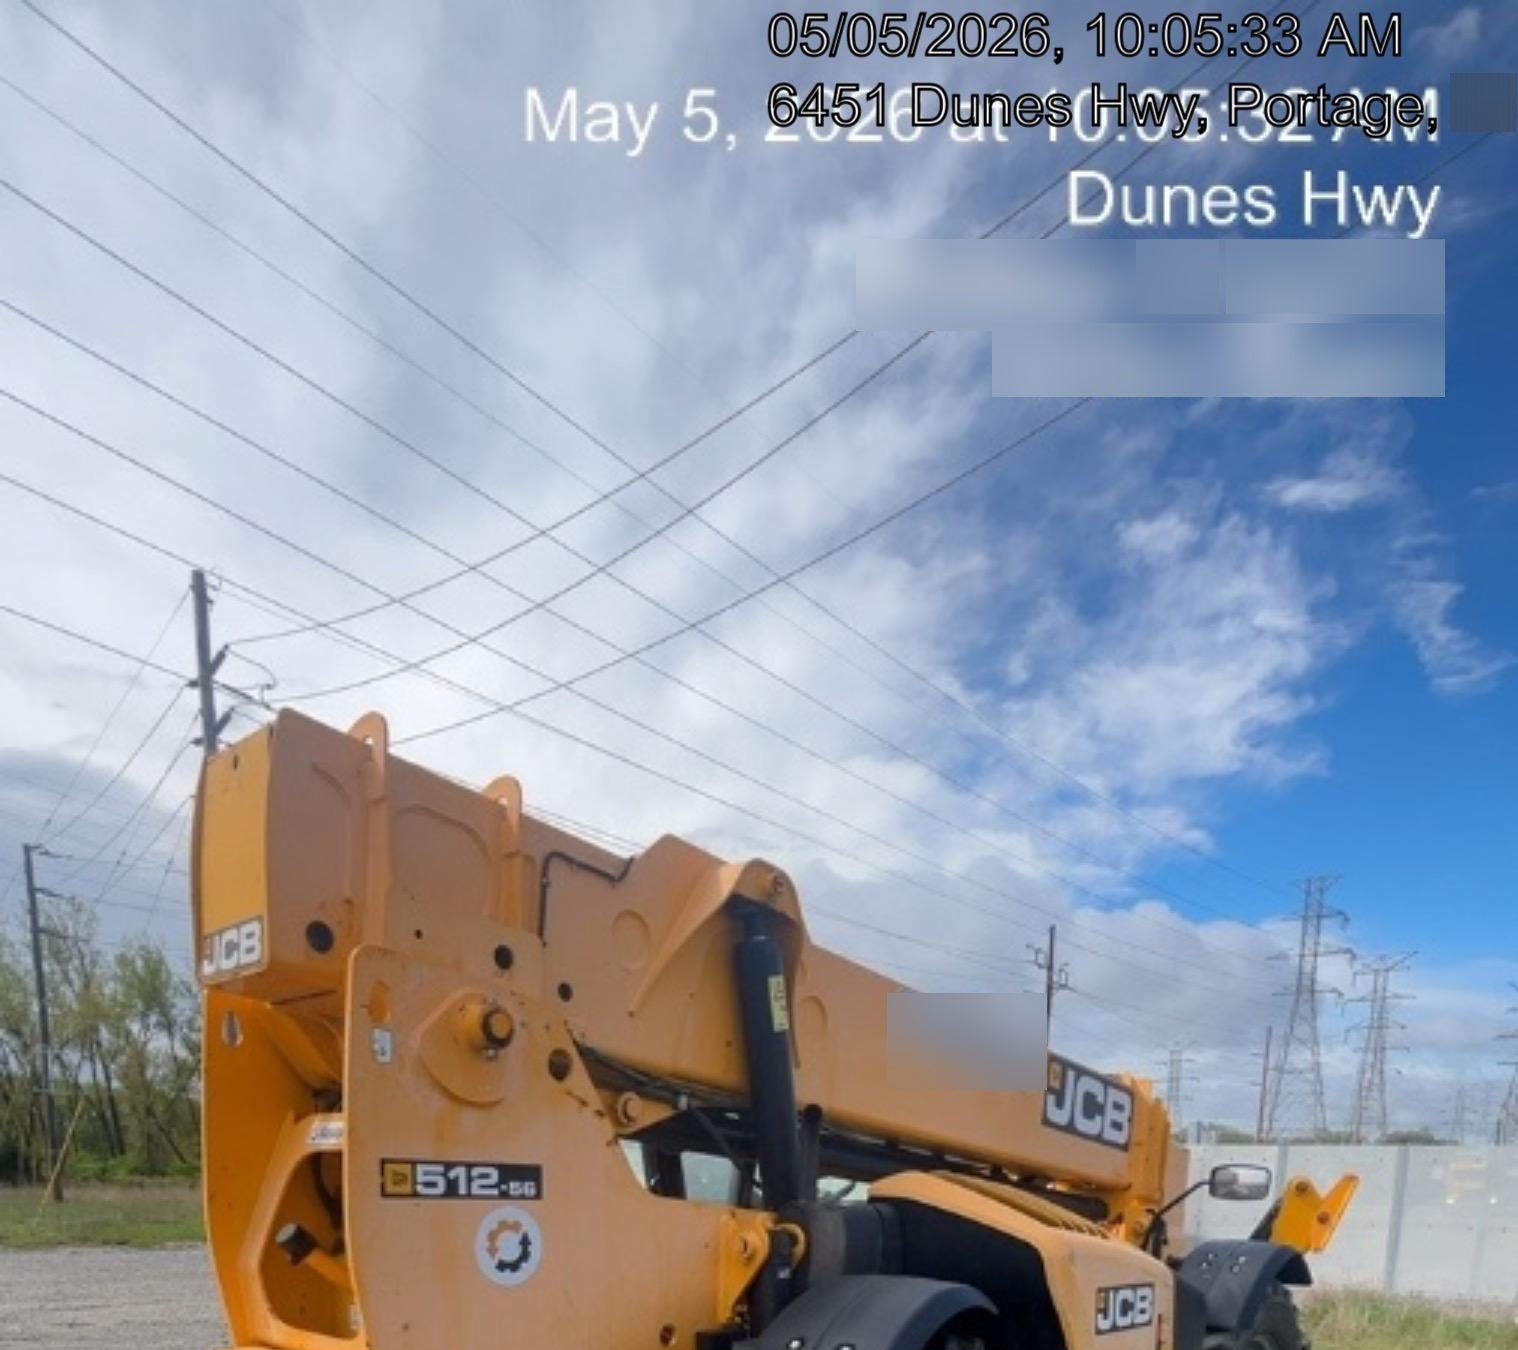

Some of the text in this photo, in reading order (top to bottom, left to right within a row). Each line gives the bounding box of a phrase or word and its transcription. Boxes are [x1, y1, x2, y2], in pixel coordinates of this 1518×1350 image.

[203, 920, 262, 976] JCB
[1046, 1067, 1132, 1144] JCB
[1097, 1286, 1153, 1331] JCB
